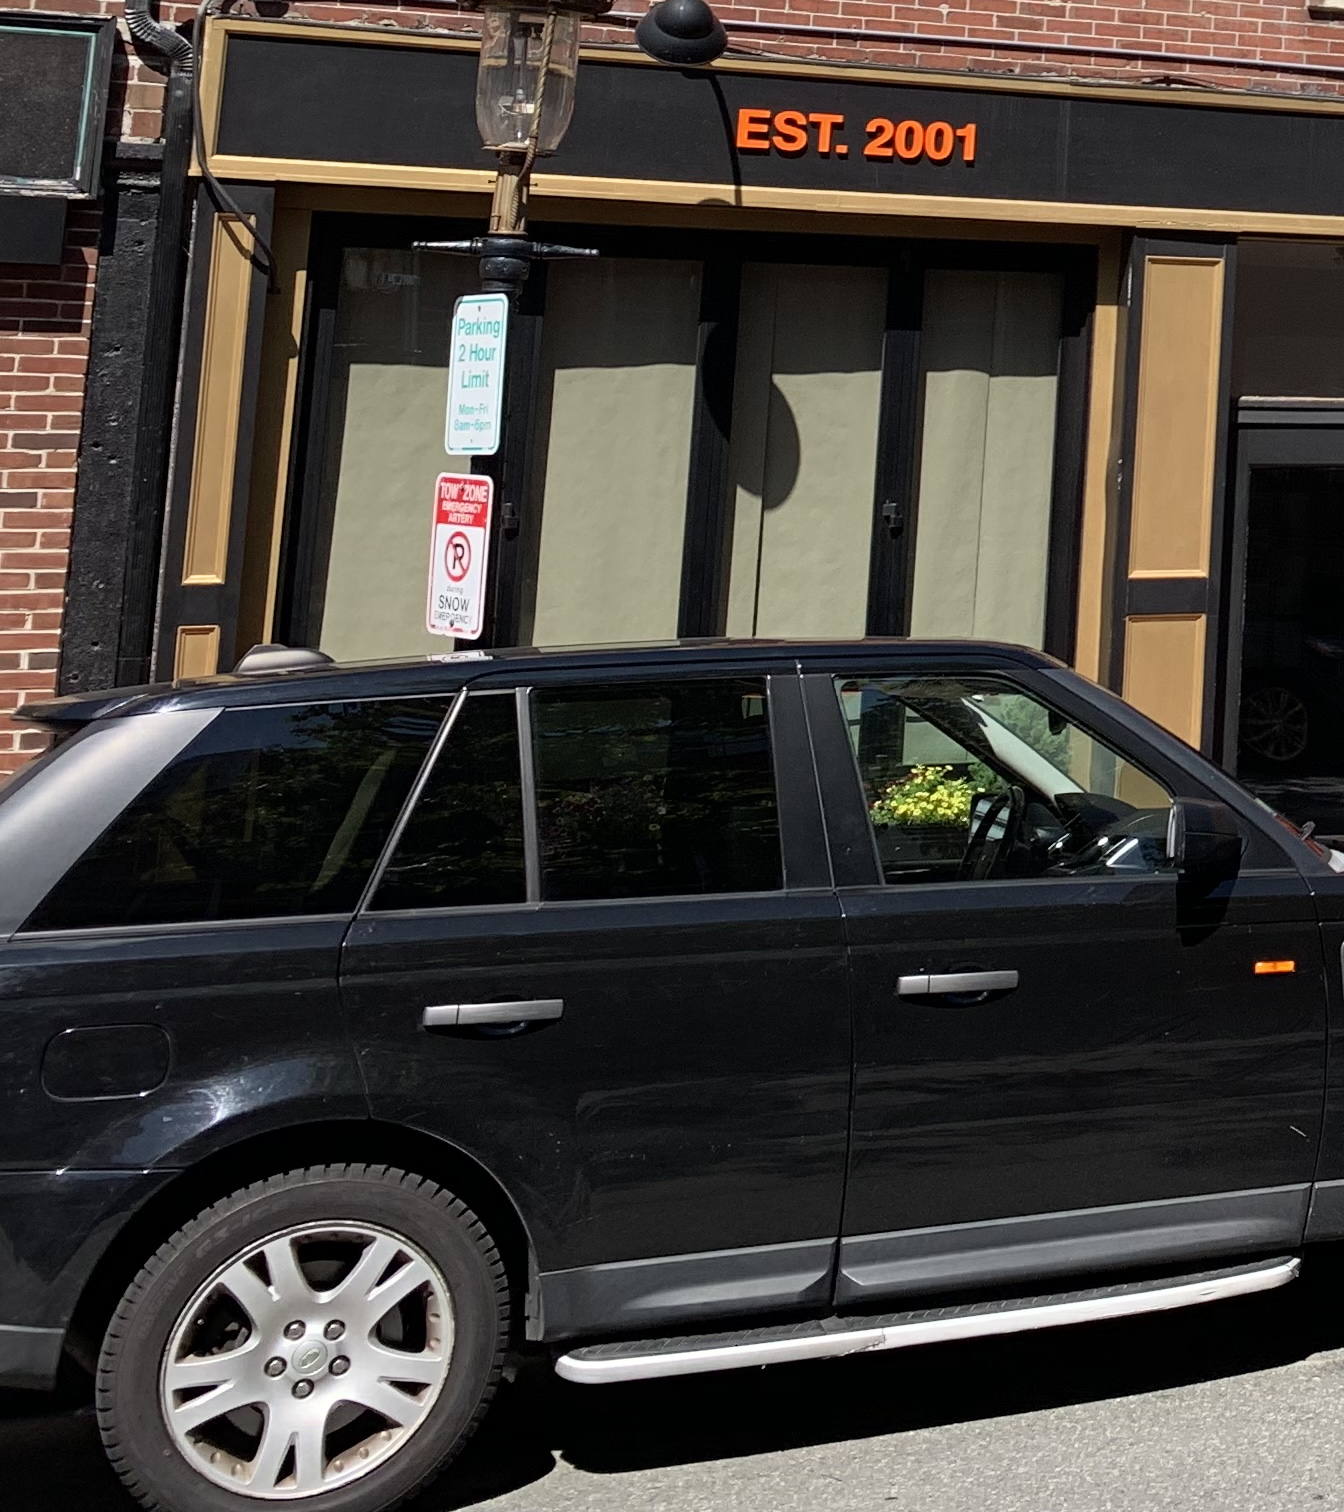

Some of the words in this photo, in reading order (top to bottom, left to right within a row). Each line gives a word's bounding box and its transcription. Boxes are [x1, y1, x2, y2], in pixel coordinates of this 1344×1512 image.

[736, 108, 849, 154] EST.
[864, 118, 977, 162] 2001
[457, 318, 501, 337] Parking
[458, 344, 466, 362] 2
[469, 343, 497, 362] Hour
[461, 369, 489, 388] Limit
[440, 482, 461, 500] TOW
[462, 485, 488, 503] ZONE
[442, 501, 481, 514] EMERGENCY
[438, 594, 470, 613] SNOW
